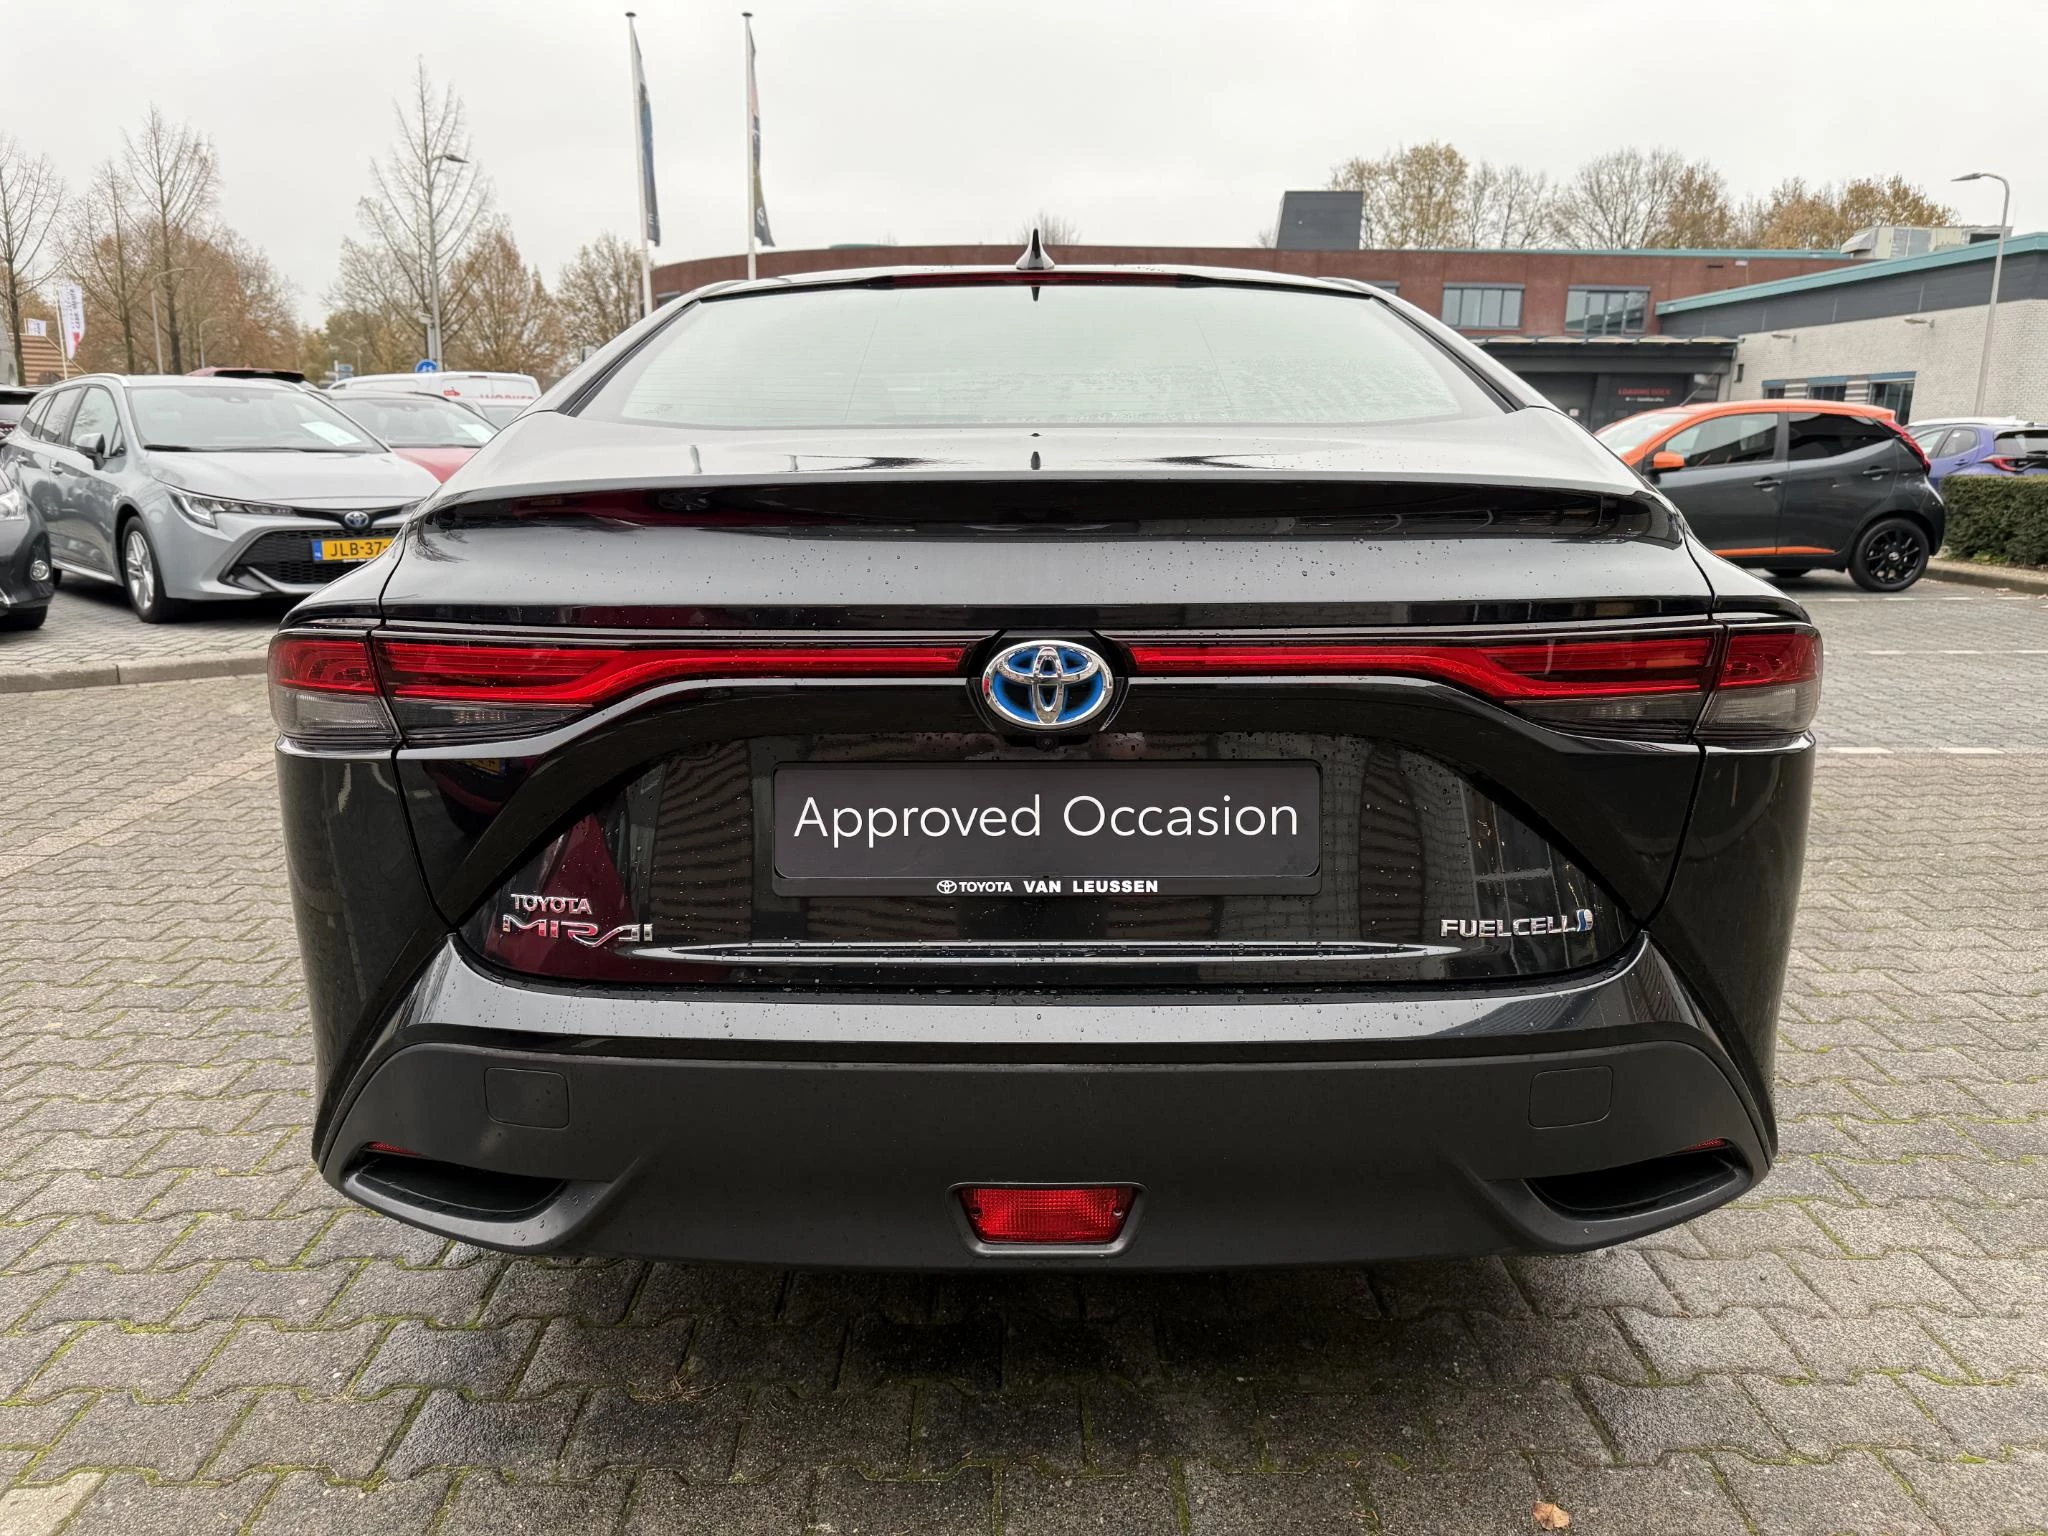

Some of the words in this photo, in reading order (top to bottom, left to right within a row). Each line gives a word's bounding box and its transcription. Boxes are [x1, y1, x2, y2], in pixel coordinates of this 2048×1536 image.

[793, 794, 1041, 848] Approved
[1063, 795, 1298, 837] Occasion
[959, 881, 1013, 893] TOYOTA
[1023, 880, 1062, 893] VAN
[1072, 880, 1158, 893] LEUSSEN
[510, 893, 593, 915] TOYOTA
[502, 914, 653, 948] MIRAI
